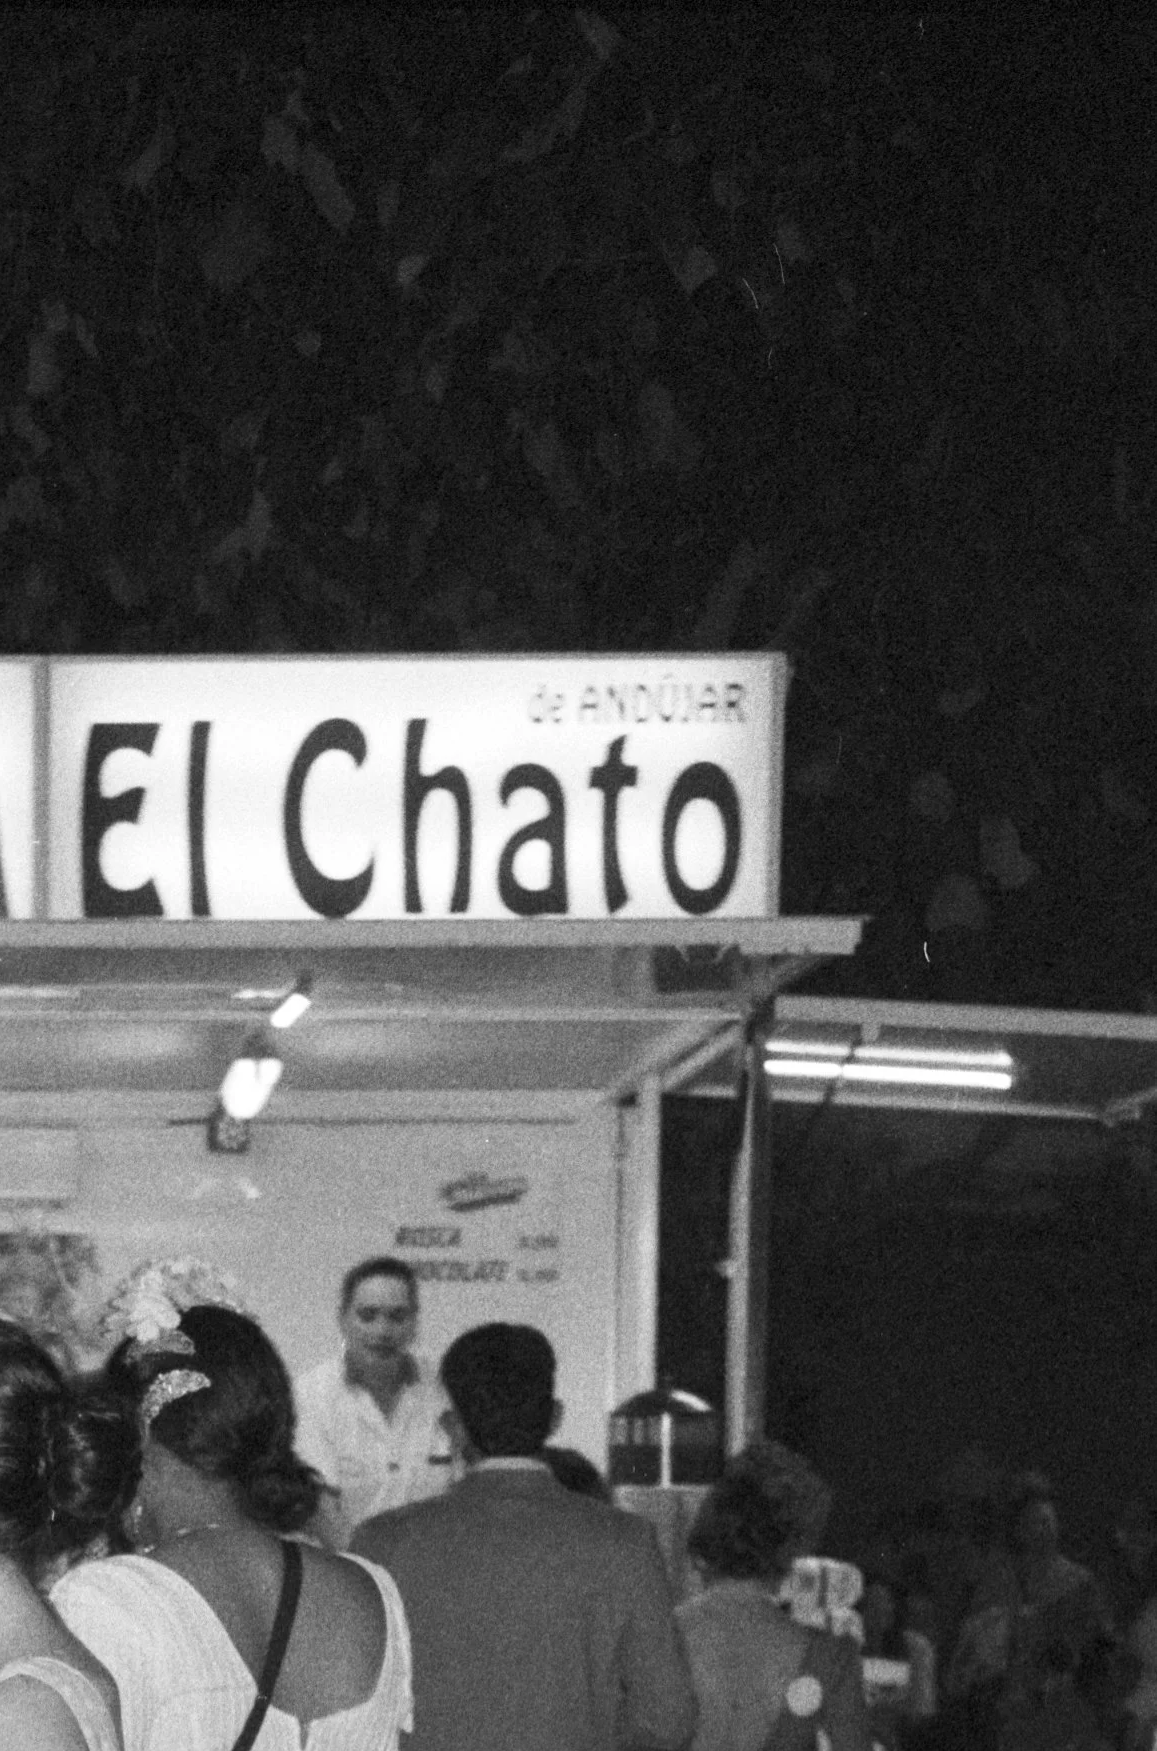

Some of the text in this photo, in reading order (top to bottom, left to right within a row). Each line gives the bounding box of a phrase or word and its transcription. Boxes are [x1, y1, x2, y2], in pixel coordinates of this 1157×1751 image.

[529, 682, 565, 724] de
[80, 717, 742, 918] El Chato
